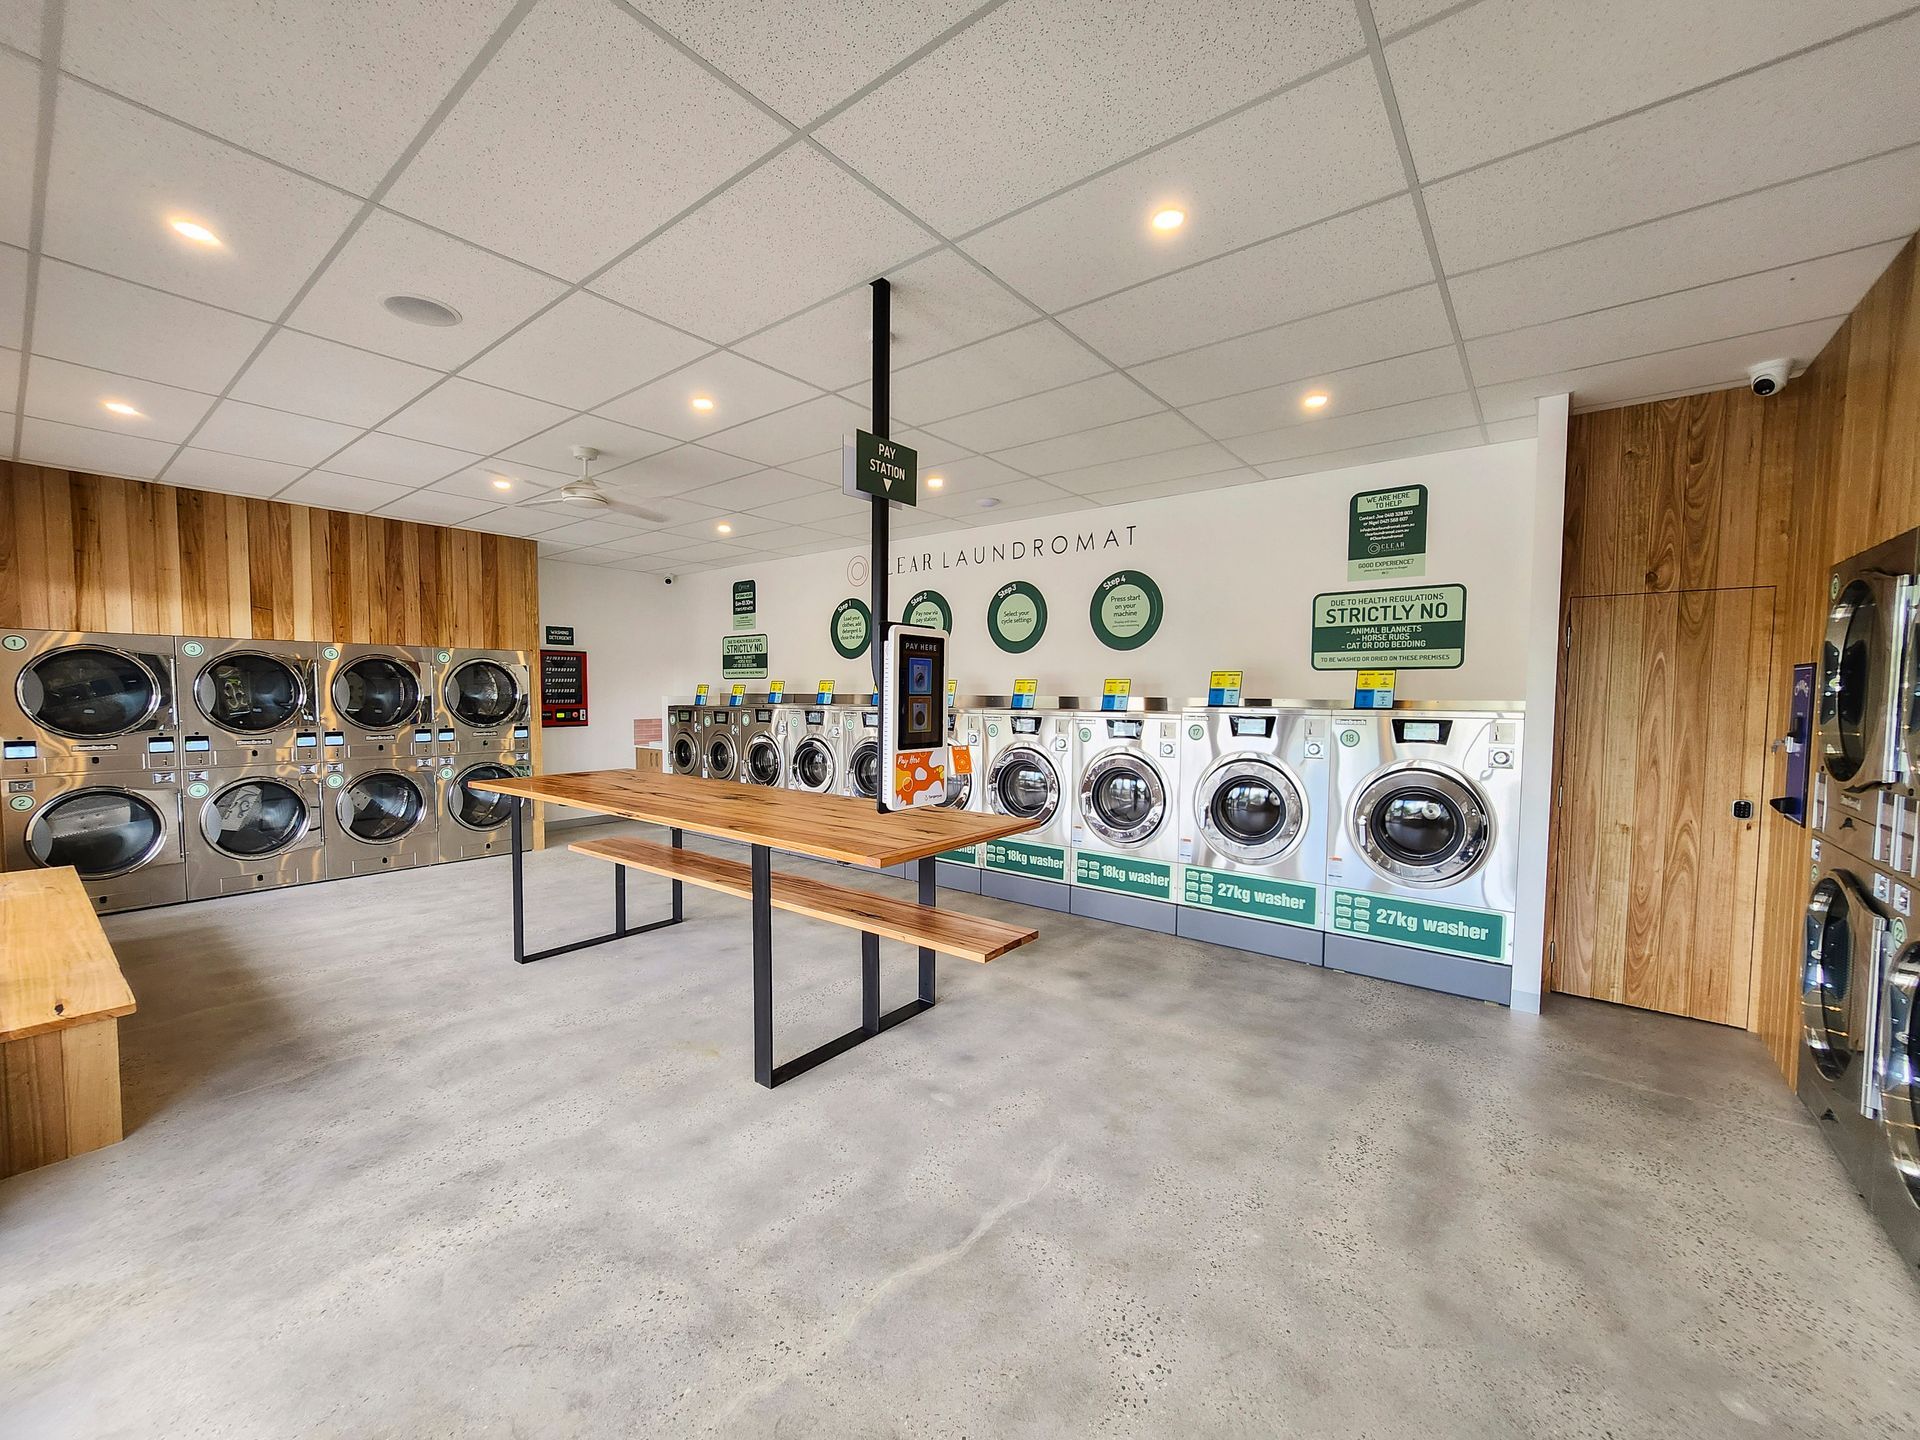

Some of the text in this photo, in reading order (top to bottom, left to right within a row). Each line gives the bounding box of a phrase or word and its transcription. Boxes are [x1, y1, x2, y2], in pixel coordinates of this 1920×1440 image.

[878, 443, 896, 460] PAY
[870, 458, 906, 481] STATION
[1385, 500, 1402, 508] HELP
[943, 525, 1136, 569] LAUNDROMAT
[1375, 559, 1414, 567] EXPERIENCE?
[1102, 575, 1126, 591] Step 4
[998, 586, 1012, 599] Step
[911, 594, 923, 606] Step
[1331, 598, 1344, 606] DUE
[1358, 596, 1387, 604] HEALTH
[1390, 593, 1444, 602] REGULATIONS
[837, 603, 849, 613] Step
[1326, 602, 1448, 624] STRICTLY NO
[1351, 627, 1379, 635] ANIMAL
[1382, 624, 1422, 633] BLANKETS
[727, 643, 763, 653] STRICTLY NO
[920, 643, 937, 651] HERE
[1192, 727, 1200, 736] 17
[1344, 733, 1355, 743] 18
[897, 753, 908, 768] Pay
[1007, 850, 1064, 868] 18kg washer
[1101, 864, 1170, 887] 18kg washer
[1217, 883, 1306, 910] 27kg washer
[1376, 908, 1489, 941] 27kg washer
